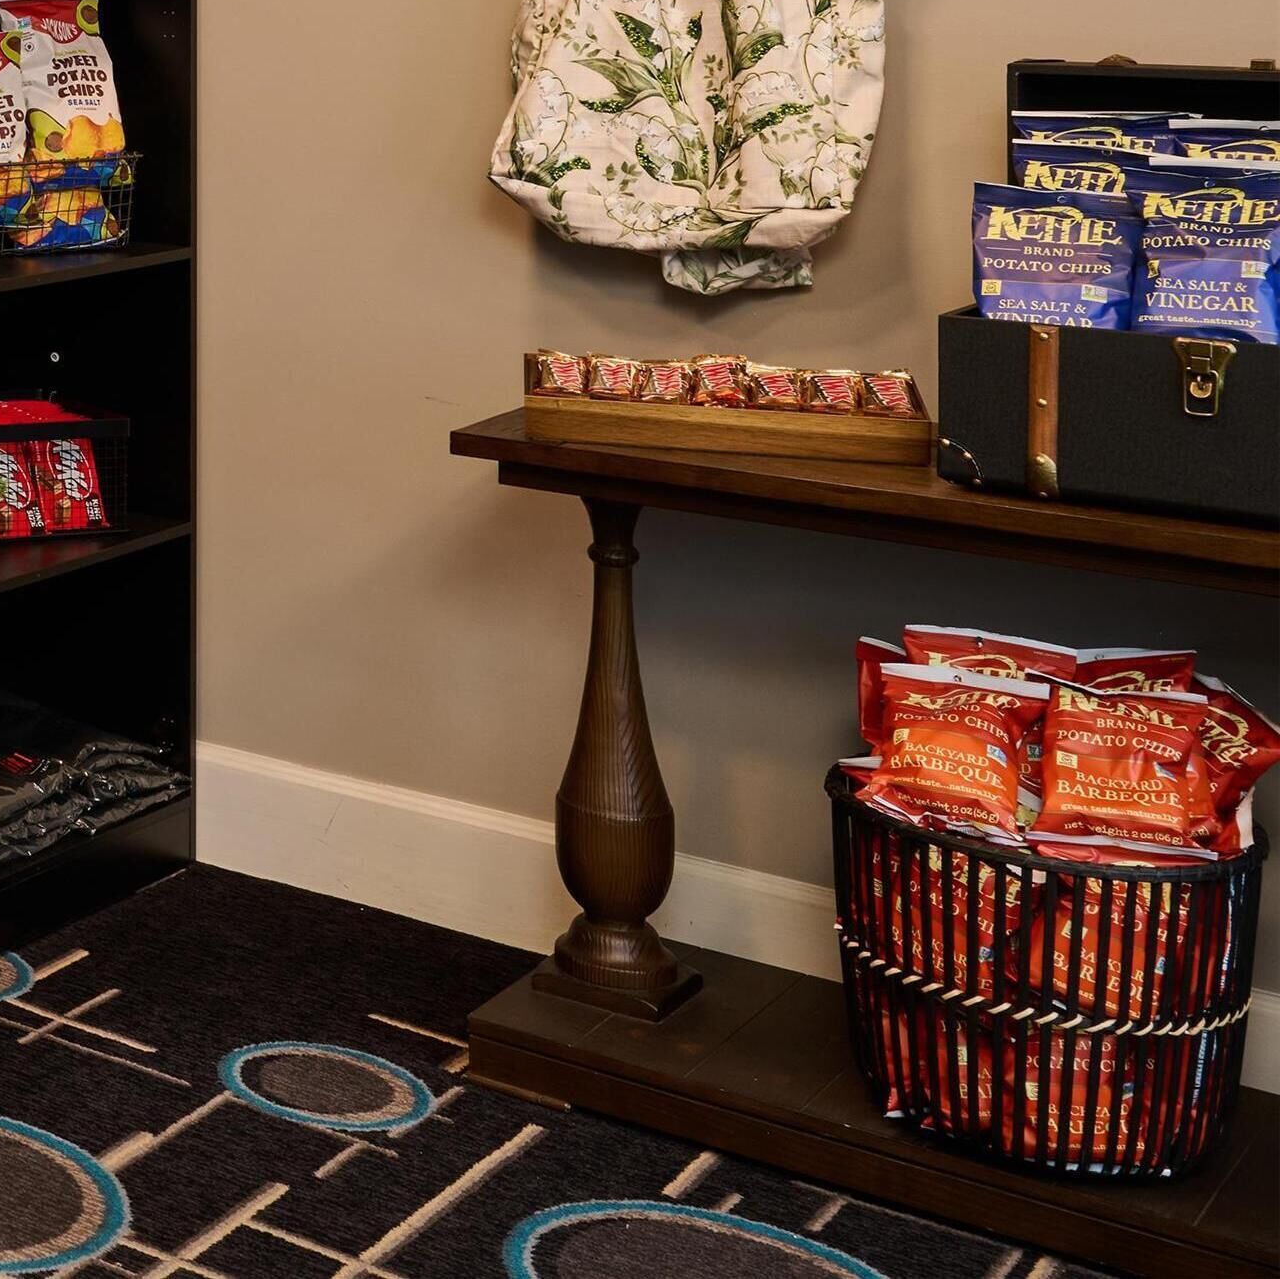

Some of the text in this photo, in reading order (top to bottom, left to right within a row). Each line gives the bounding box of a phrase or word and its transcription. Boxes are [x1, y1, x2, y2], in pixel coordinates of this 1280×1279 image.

[41, 17, 79, 43] JACKSON'S
[51, 54, 98, 70] SWEET
[47, 69, 107, 86] POTATO
[57, 84, 105, 98] CHIPS
[67, 98, 101, 107] SEA SALT
[1142, 187, 1280, 226] KETTLE
[980, 205, 1123, 246] KETTLE
[1178, 221, 1234, 235] BRAND
[1143, 235, 1272, 251] POTATO CHIPS
[1024, 246, 1075, 258] BRAND
[983, 257, 1113, 275] POTATO CHIPS
[1154, 276, 1248, 293] SEA SALT &
[998, 298, 1088, 315] SEA SALT &
[1145, 291, 1259, 314] VINEGAR
[1137, 314, 1164, 323] great
[964, 715, 1010, 744] CHIPS
[1096, 717, 1148, 733] BRAND
[1057, 729, 1183, 762] POTATO CHIPS
[904, 741, 990, 768] BACKYARD
[890, 754, 1007, 792] BARBEQUE
[1075, 770, 1164, 792] BACKYARD
[1055, 779, 1185, 809] BARBEQUE
[952, 803, 960, 814] 2
[960, 806, 973, 815] oz
[1064, 820, 1083, 830] net
[1130, 829, 1139, 839] 2
[1139, 831, 1154, 840] oz
